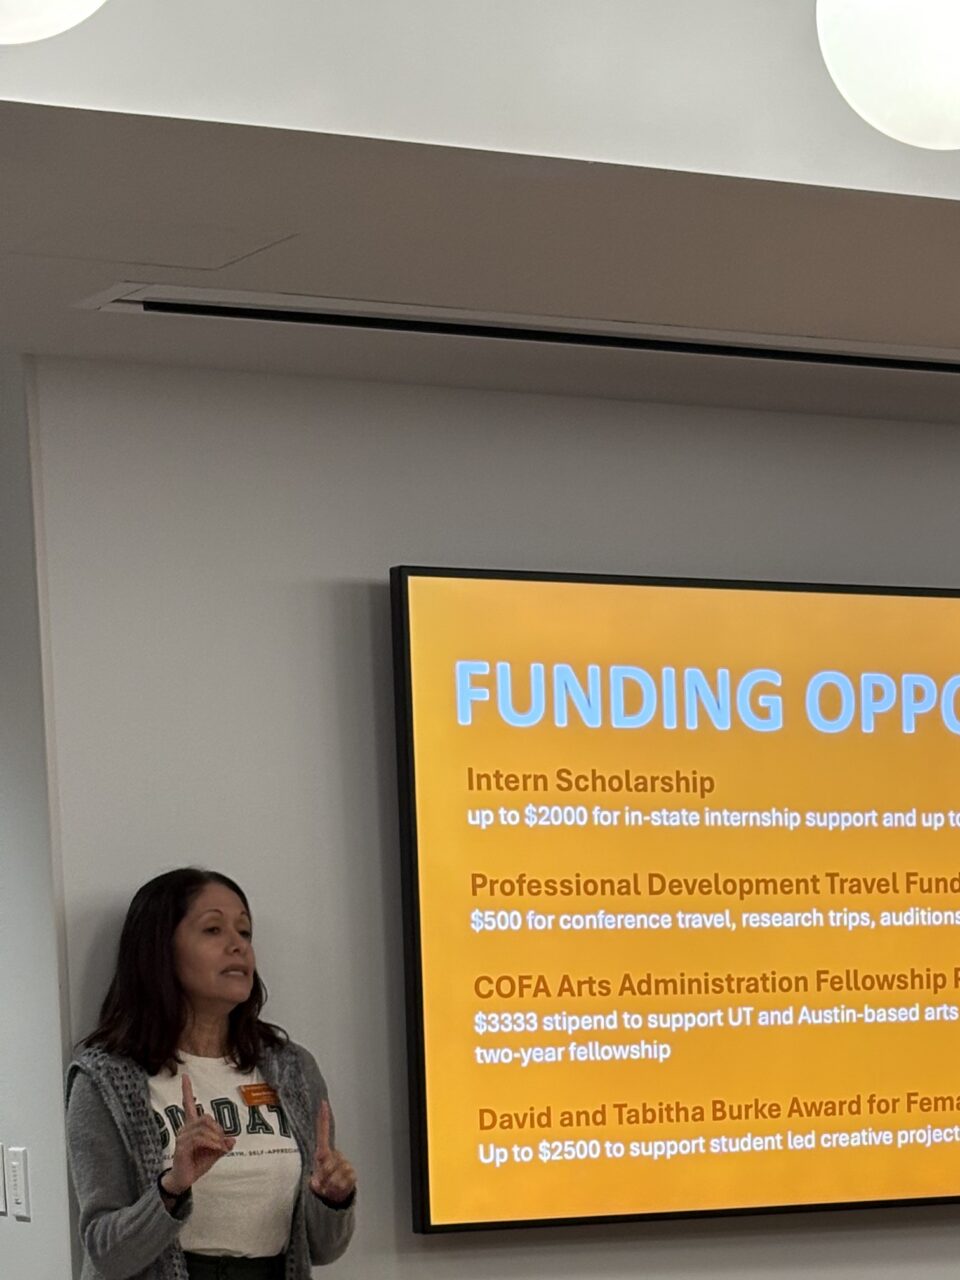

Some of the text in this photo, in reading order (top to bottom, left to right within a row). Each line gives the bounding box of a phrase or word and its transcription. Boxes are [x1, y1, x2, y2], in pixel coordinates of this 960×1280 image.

[455, 660, 783, 730] FUNDING
[468, 767, 714, 799] Intern Scholarship
[467, 809, 494, 829] up
[498, 807, 520, 825] to
[524, 803, 588, 827] $2000
[592, 806, 621, 826] for
[625, 806, 700, 826] in-state
[704, 808, 801, 830] internship
[805, 810, 878, 830] support
[882, 808, 917, 827] and
[921, 812, 945, 830] up
[471, 873, 641, 896] Professional
[648, 873, 820, 900] Development
[825, 872, 899, 894] Travel
[470, 909, 522, 933] $500
[526, 910, 555, 930] for
[559, 910, 672, 930] conference
[676, 910, 736, 930] travel,
[742, 908, 824, 927] research
[828, 908, 876, 931] trips,
[474, 975, 551, 999] COFA
[557, 975, 611, 997] Arts
[618, 971, 808, 996] Administration
[816, 968, 946, 994] Fellowship
[474, 1011, 538, 1035] $3333
[542, 1011, 618, 1034] stipend
[622, 1012, 643, 1029] to
[647, 1009, 723, 1032] support
[728, 1007, 753, 1027] UT
[758, 1007, 793, 1026] and
[798, 1004, 919, 1024] Austin-based
[925, 1004, 959, 1021] arts
[474, 1040, 671, 1067] two-year fellowship
[479, 1106, 551, 1130] David
[560, 1104, 606, 1127] and
[613, 1102, 704, 1125] Tabitha
[712, 1098, 781, 1121] Burke
[787, 1094, 861, 1118] Award
[867, 1094, 900, 1114] for
[479, 1144, 509, 1167] Up
[512, 1145, 533, 1162] to
[538, 1139, 601, 1162] $2500
[604, 1141, 625, 1158] to
[630, 1136, 705, 1160] support
[710, 1133, 783, 1153] student
[787, 1131, 816, 1149] led
[820, 1128, 893, 1148] creative
